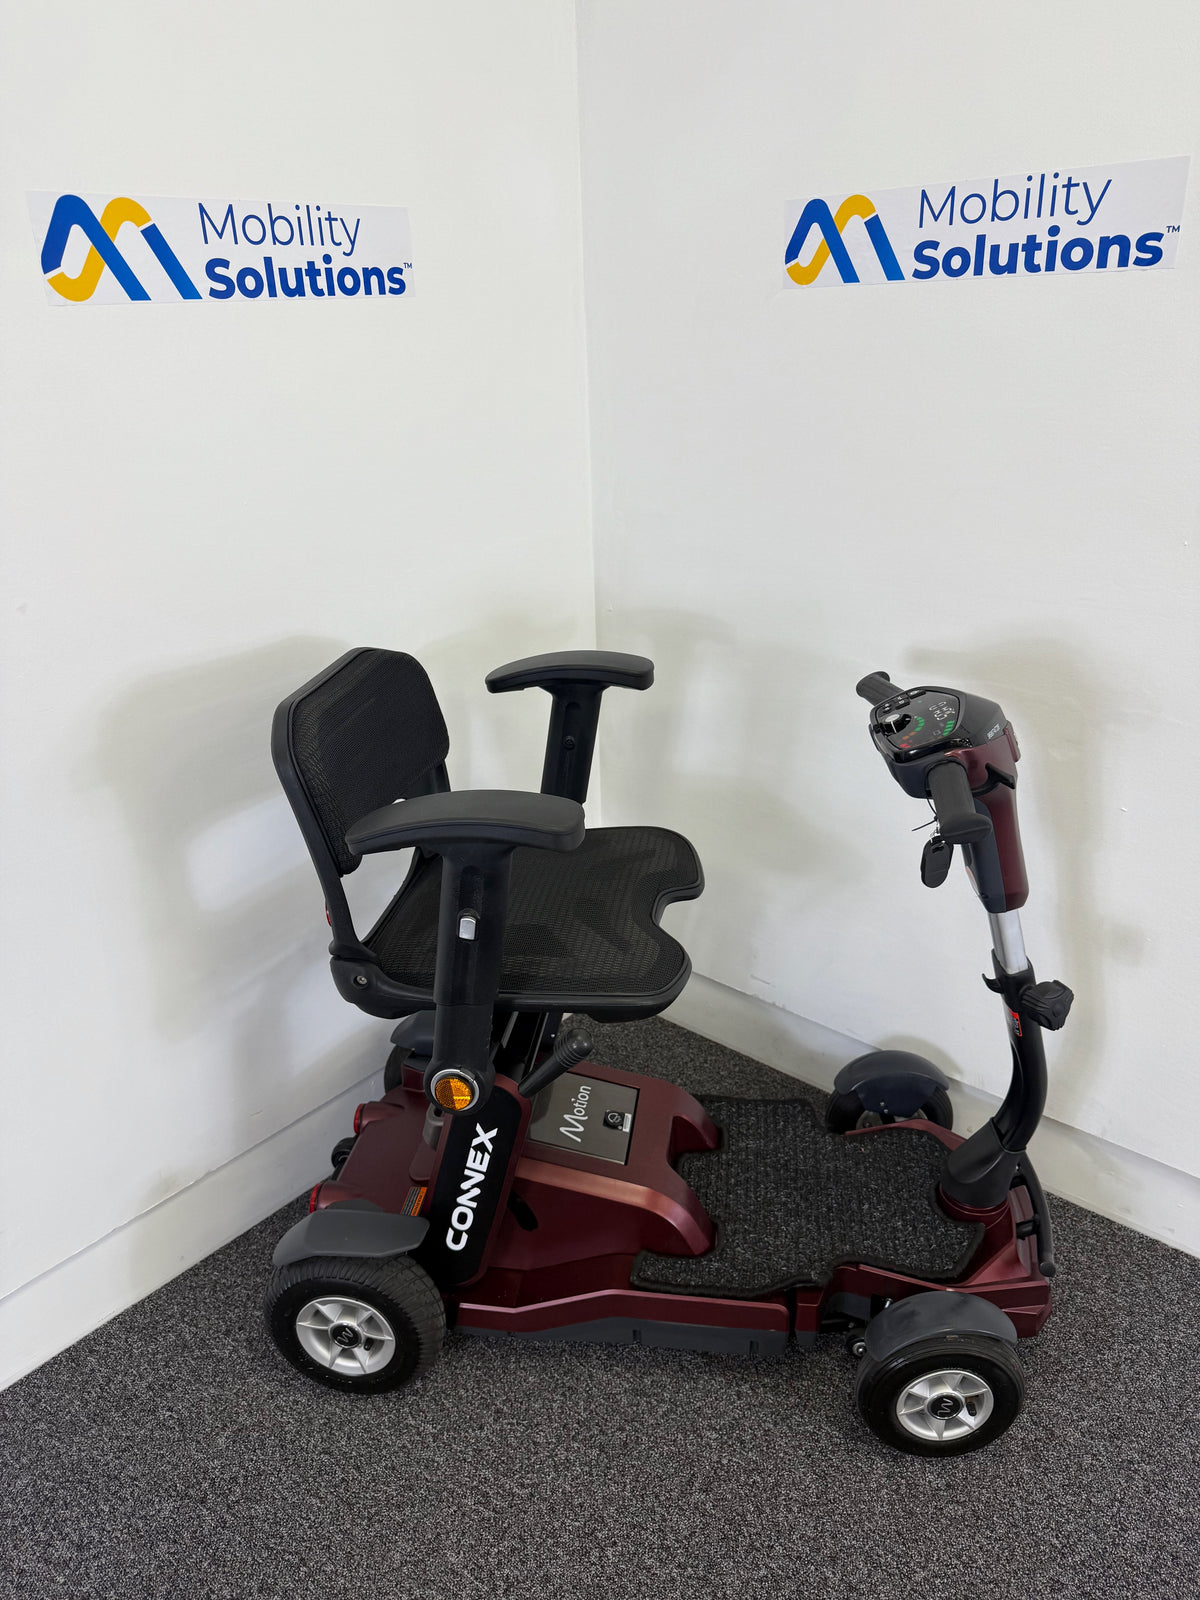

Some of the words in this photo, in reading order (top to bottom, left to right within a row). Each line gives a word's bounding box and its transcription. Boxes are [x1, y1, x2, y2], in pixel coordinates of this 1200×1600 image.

[918, 172, 1112, 228] Mobility
[198, 202, 361, 256] Mobility
[911, 225, 1164, 280] Solutions
[205, 254, 406, 299] Solutions
[559, 1085, 592, 1143] Motion
[445, 1122, 498, 1251] CONNEX
